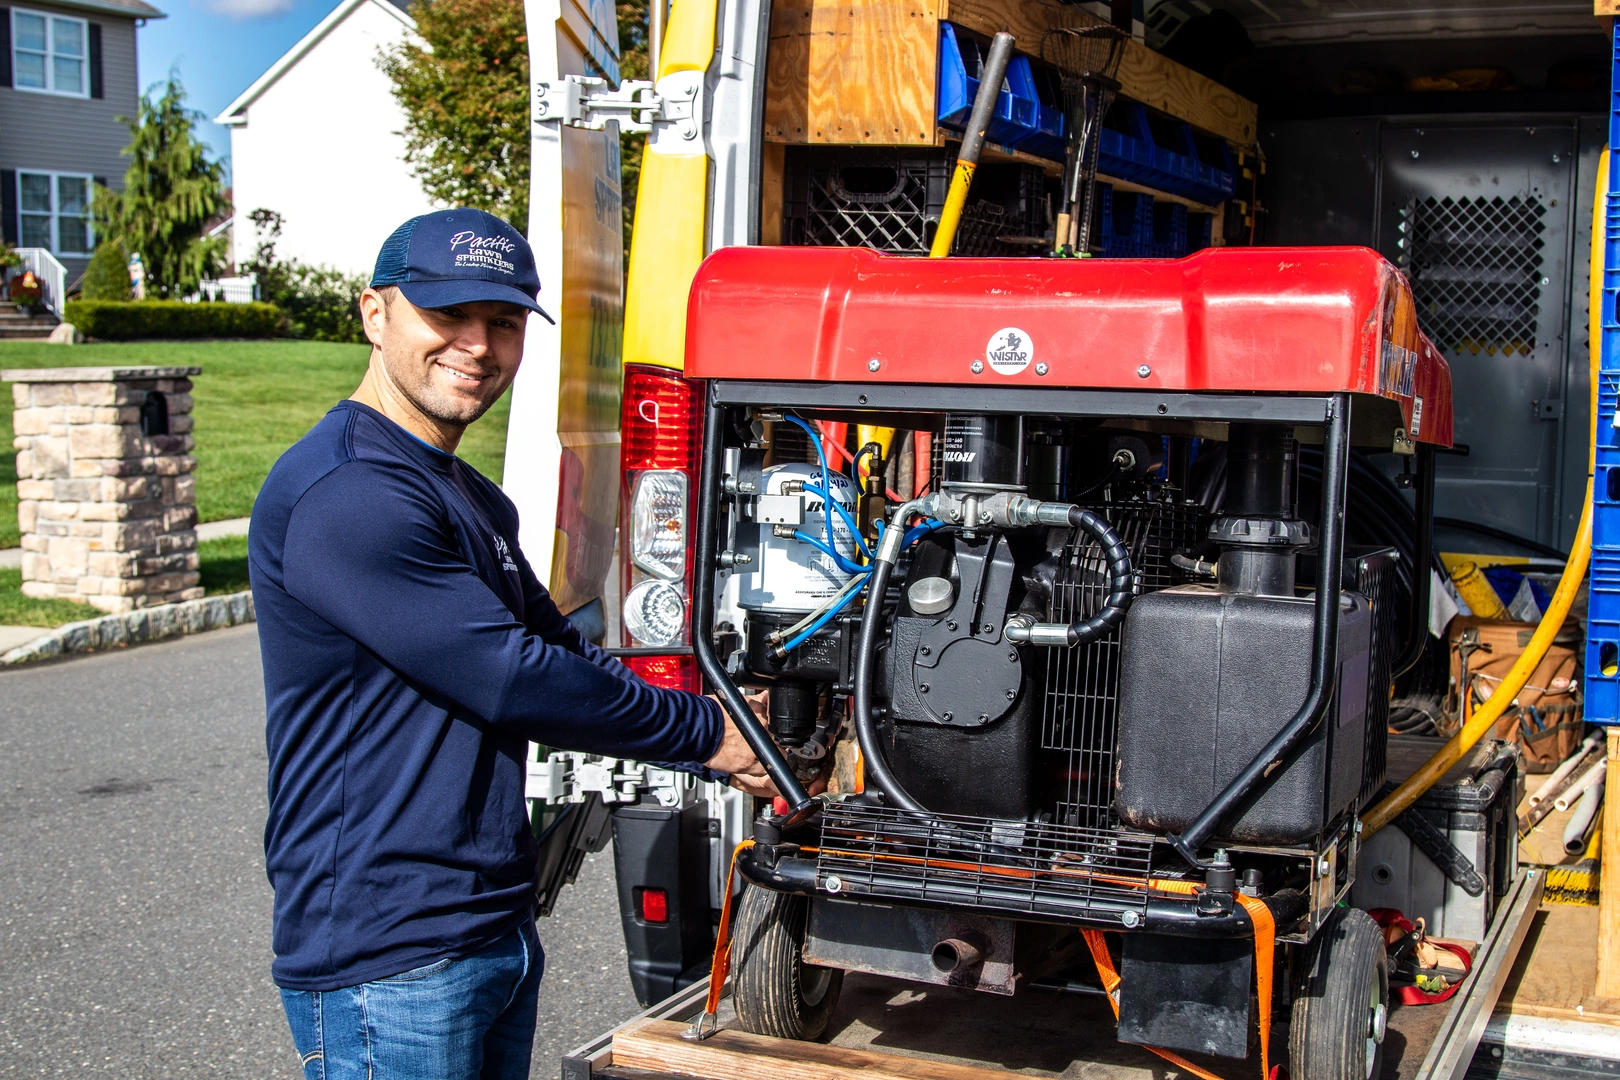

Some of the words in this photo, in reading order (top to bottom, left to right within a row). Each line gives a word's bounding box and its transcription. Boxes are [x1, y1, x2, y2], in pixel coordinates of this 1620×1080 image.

[450, 231, 515, 253] Pacific
[468, 248, 502, 260] LAWN
[455, 254, 514, 271] SPRINKLERS
[989, 351, 1027, 361] WISTAR
